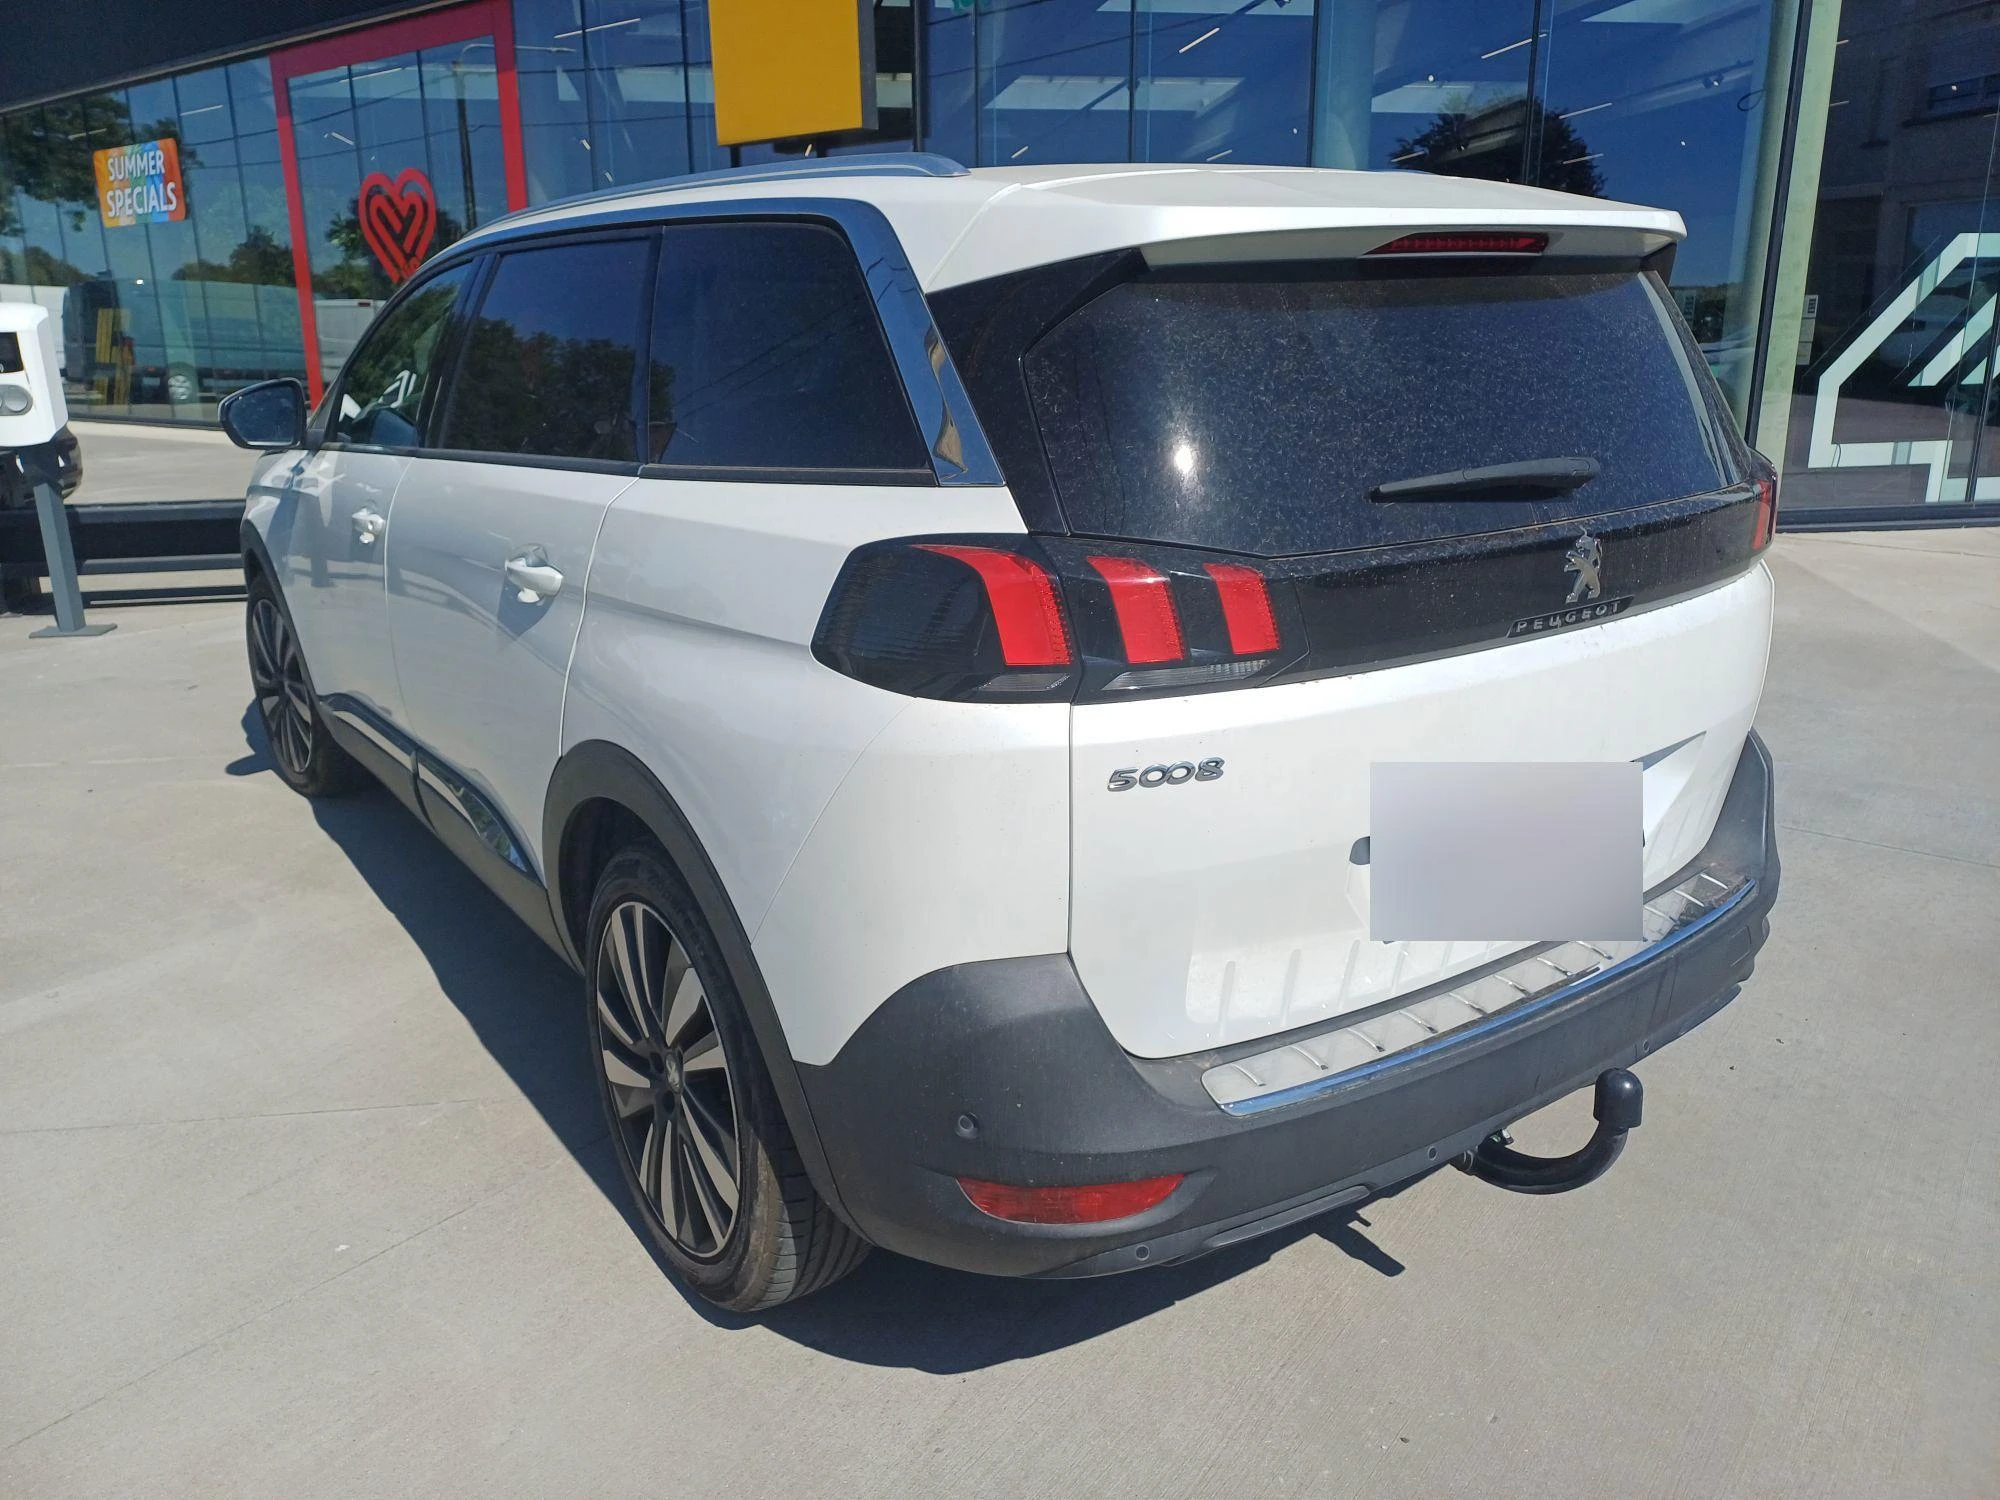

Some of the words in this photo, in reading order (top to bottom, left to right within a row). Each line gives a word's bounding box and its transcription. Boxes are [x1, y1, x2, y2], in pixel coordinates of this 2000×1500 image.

[107, 150, 165, 181] SUMMER
[106, 181, 177, 217] SPECIALS
[1515, 600, 1621, 633] PEUGEOT
[1107, 757, 1225, 792] 5008
